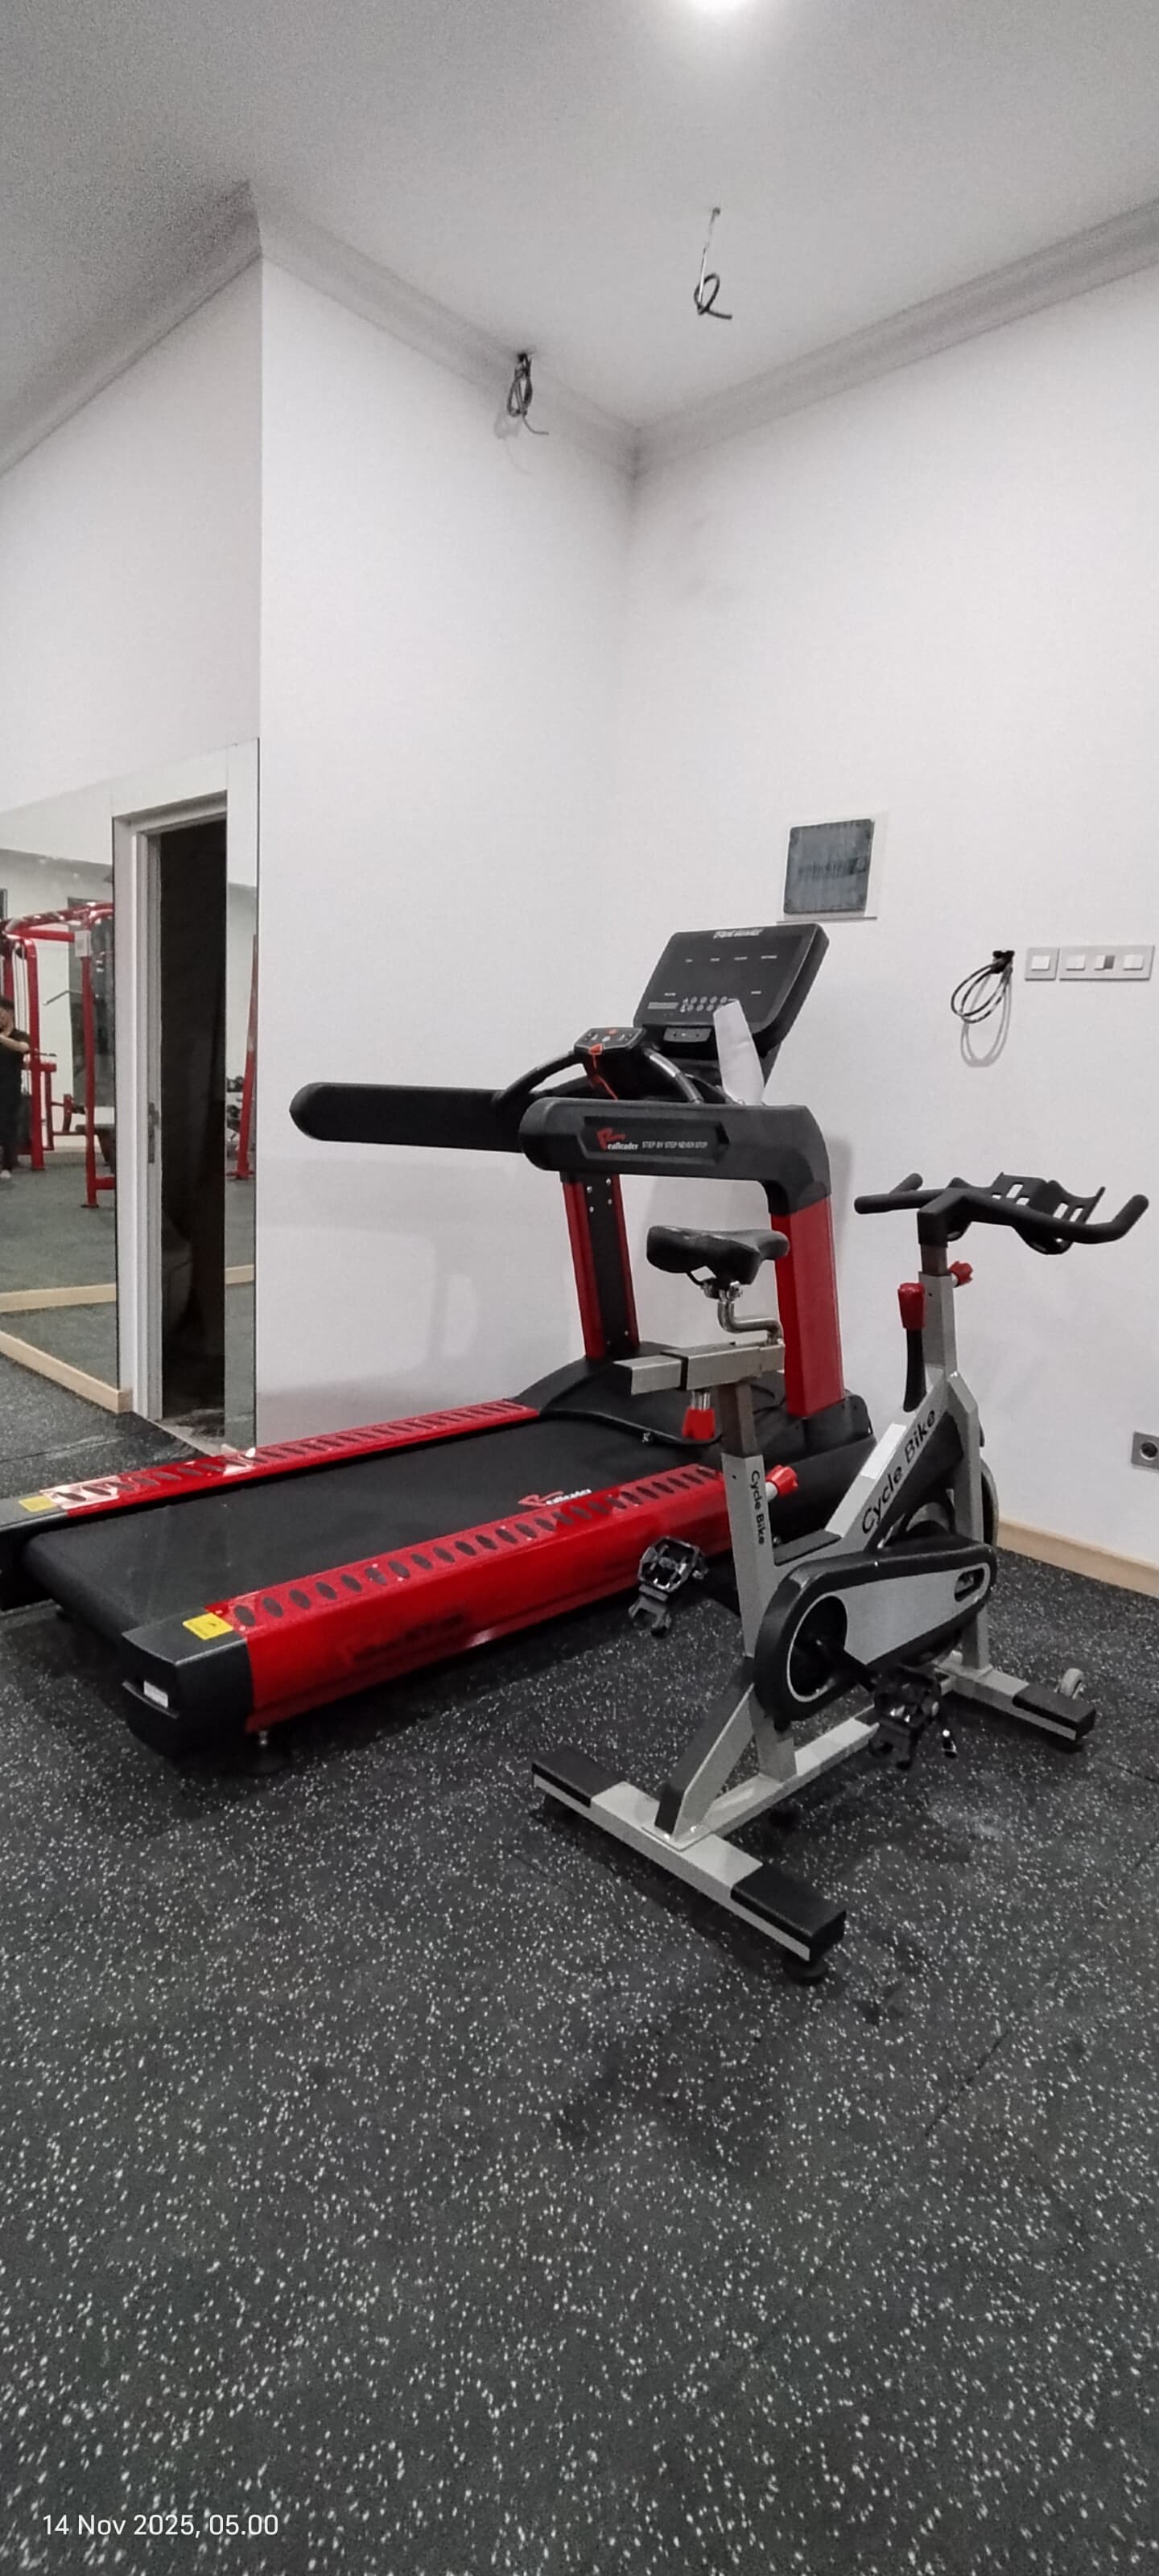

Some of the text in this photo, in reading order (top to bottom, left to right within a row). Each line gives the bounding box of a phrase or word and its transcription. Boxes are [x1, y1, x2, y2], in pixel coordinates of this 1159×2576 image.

[750, 1470, 765, 1545] Cycle Bike
[862, 1410, 935, 1534] Cycle Bike
